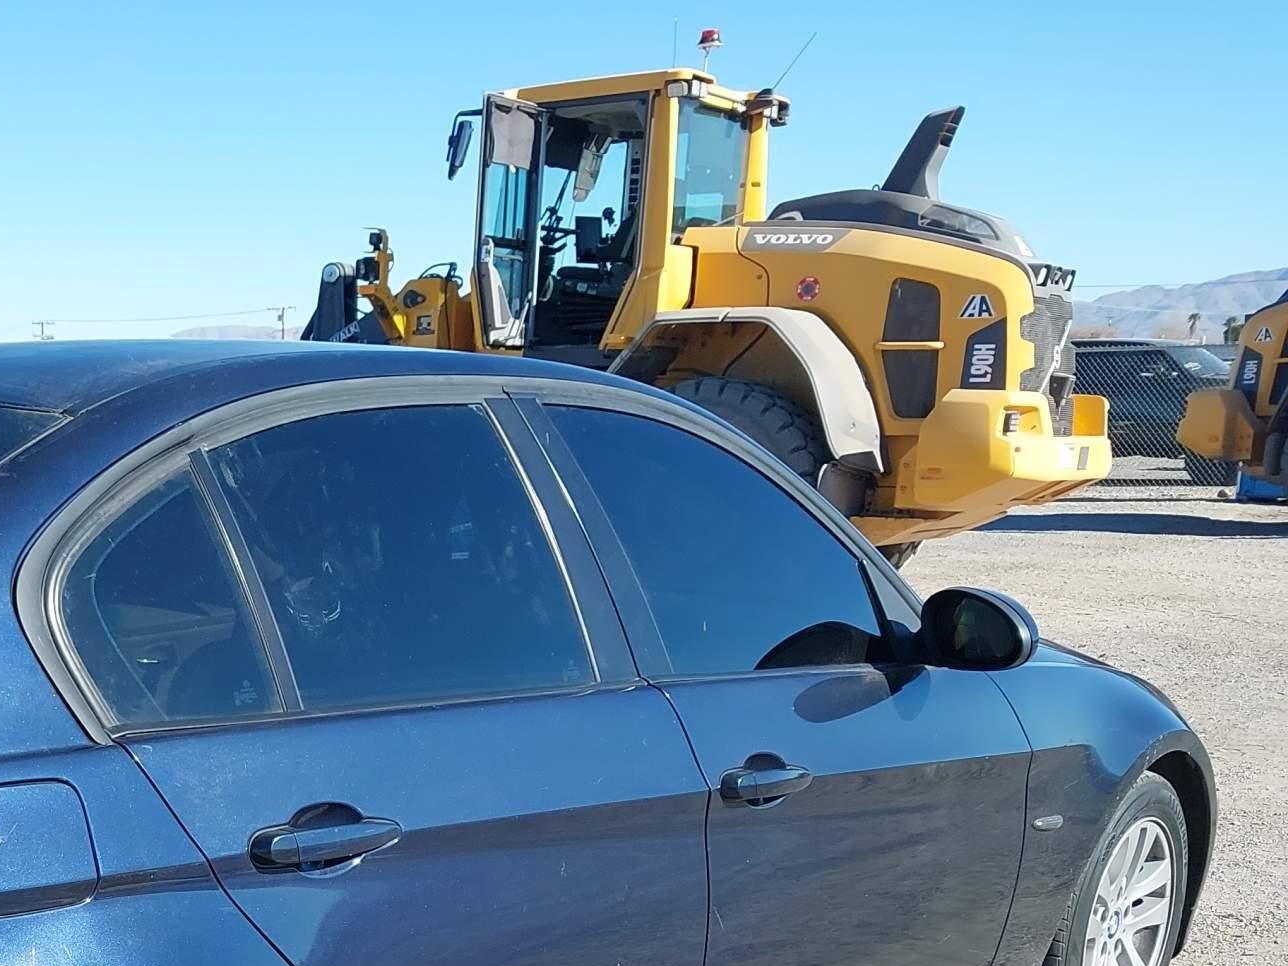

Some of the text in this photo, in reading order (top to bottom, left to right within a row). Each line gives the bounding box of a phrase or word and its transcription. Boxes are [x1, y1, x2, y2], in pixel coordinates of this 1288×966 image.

[753, 233, 834, 245] VOLVO
[968, 343, 996, 383] L90H
[1243, 360, 1258, 384] L90H
